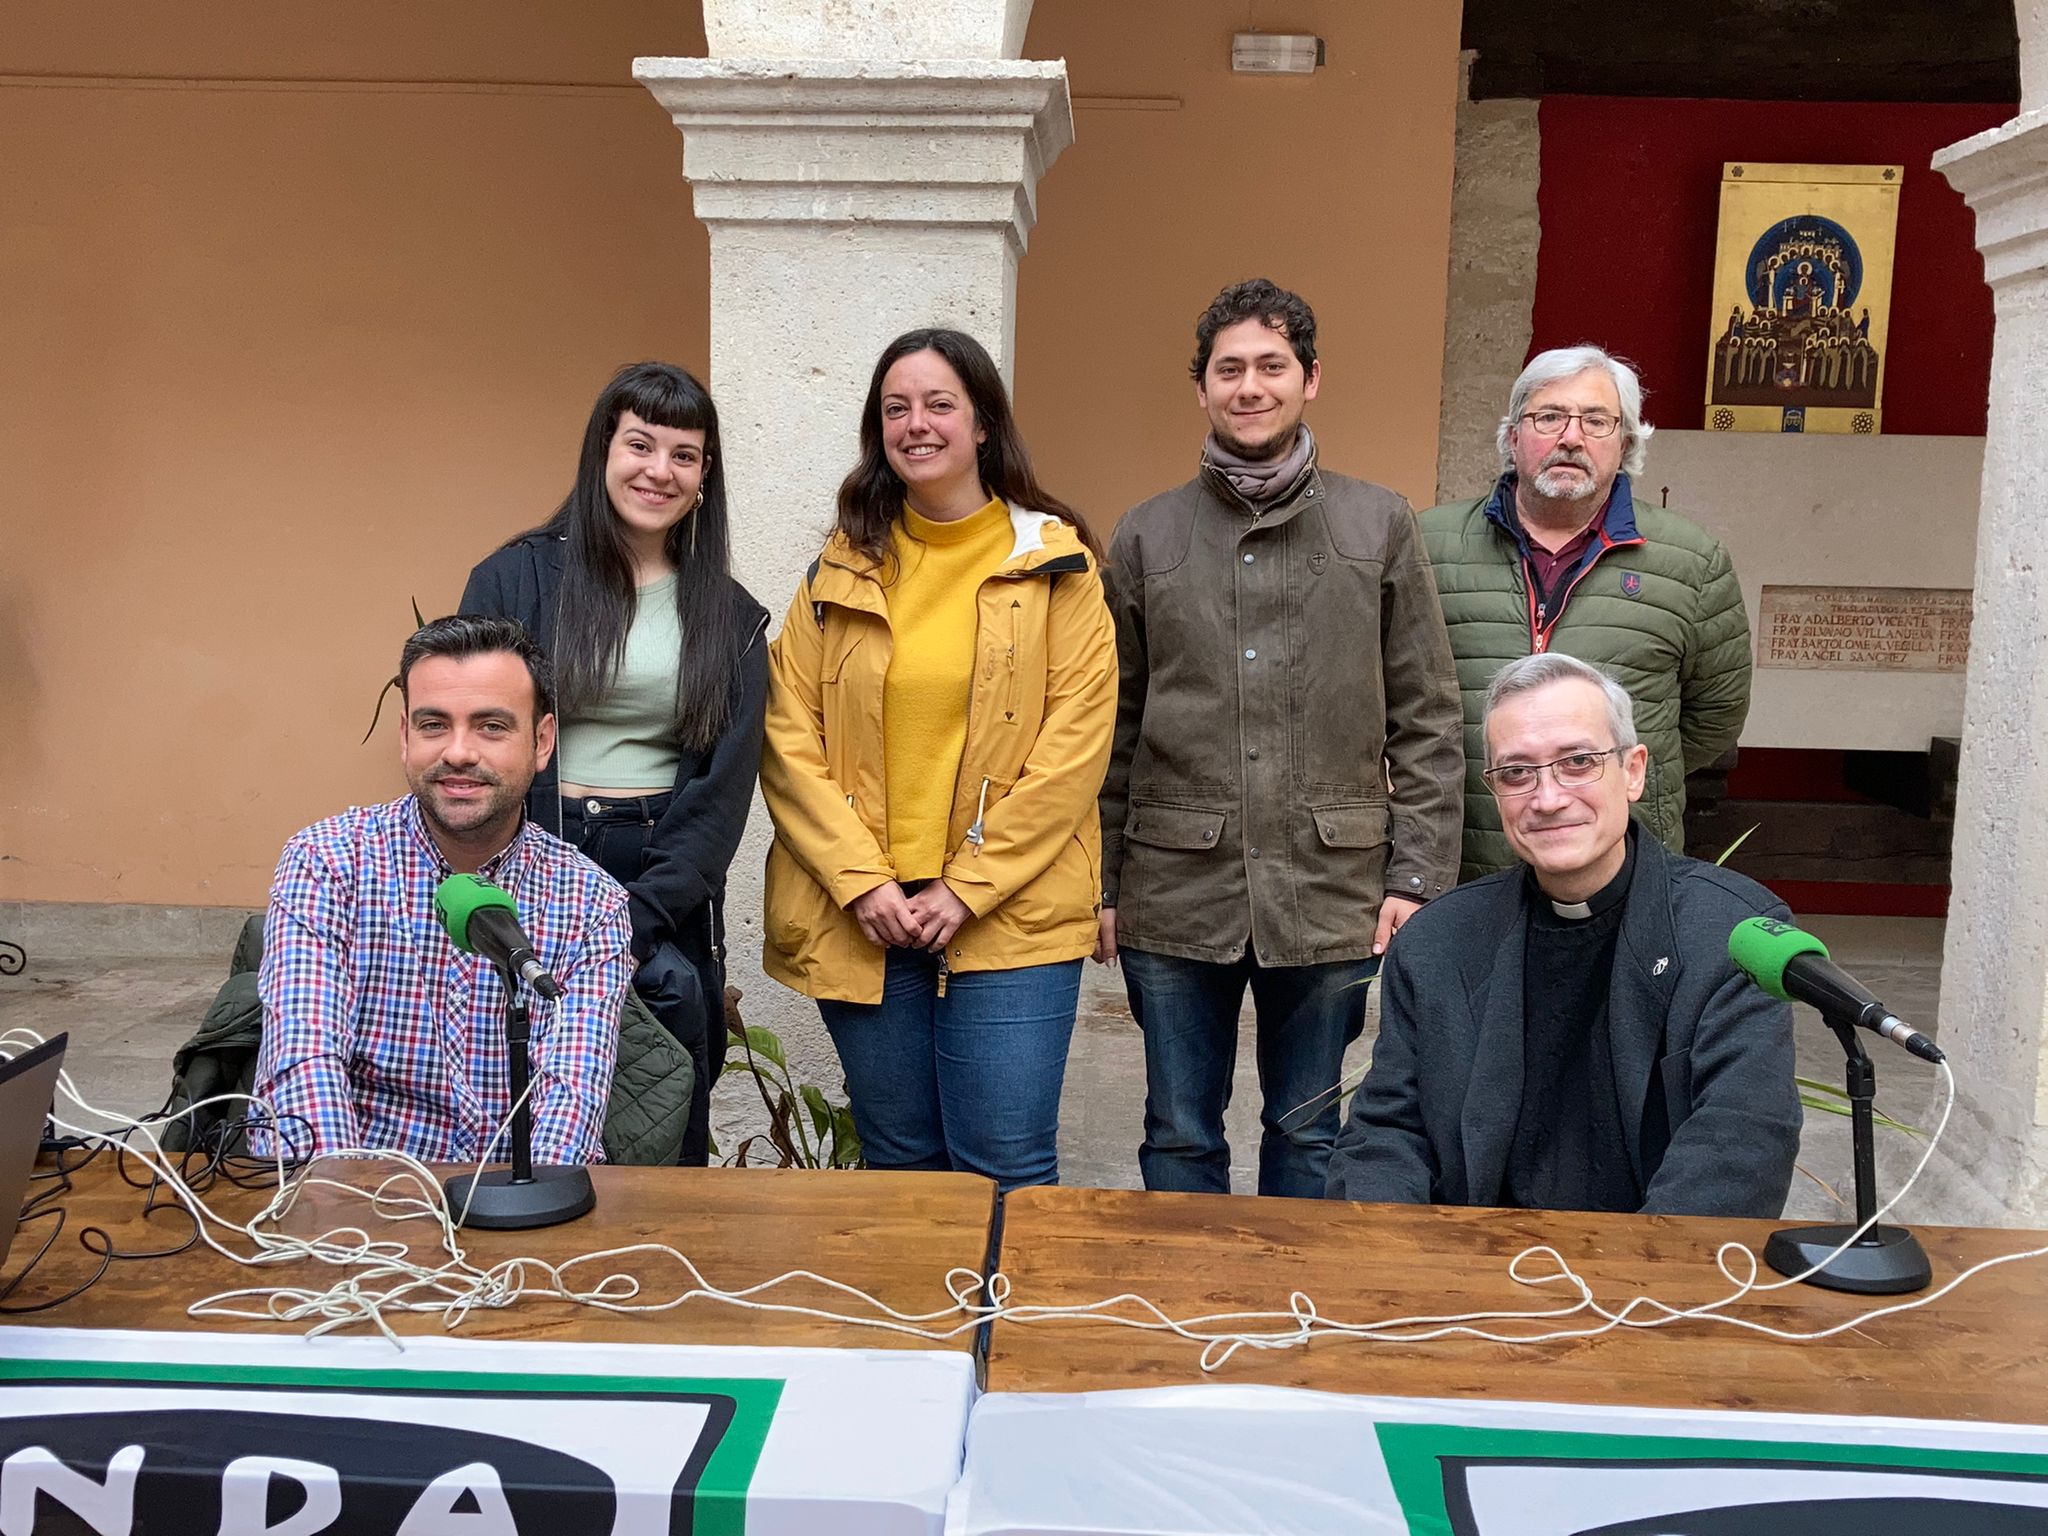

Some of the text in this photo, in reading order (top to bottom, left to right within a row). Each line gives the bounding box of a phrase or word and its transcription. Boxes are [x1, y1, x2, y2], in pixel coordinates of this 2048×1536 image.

[1774, 613, 1802, 624] FRAY
[1804, 613, 1875, 626] ADALBERTO
[1878, 615, 1928, 628] VICENTE
[1773, 625, 1800, 636] FRAY
[1803, 626, 1852, 637] SILVANO
[1856, 627, 1933, 640] VILLANUEVA
[1772, 637, 1799, 648] FRAY
[1801, 638, 1871, 650] BARTOLOME
[1770, 649, 1798, 660] FRAY
[1850, 652, 1907, 664] SANCHEZ
